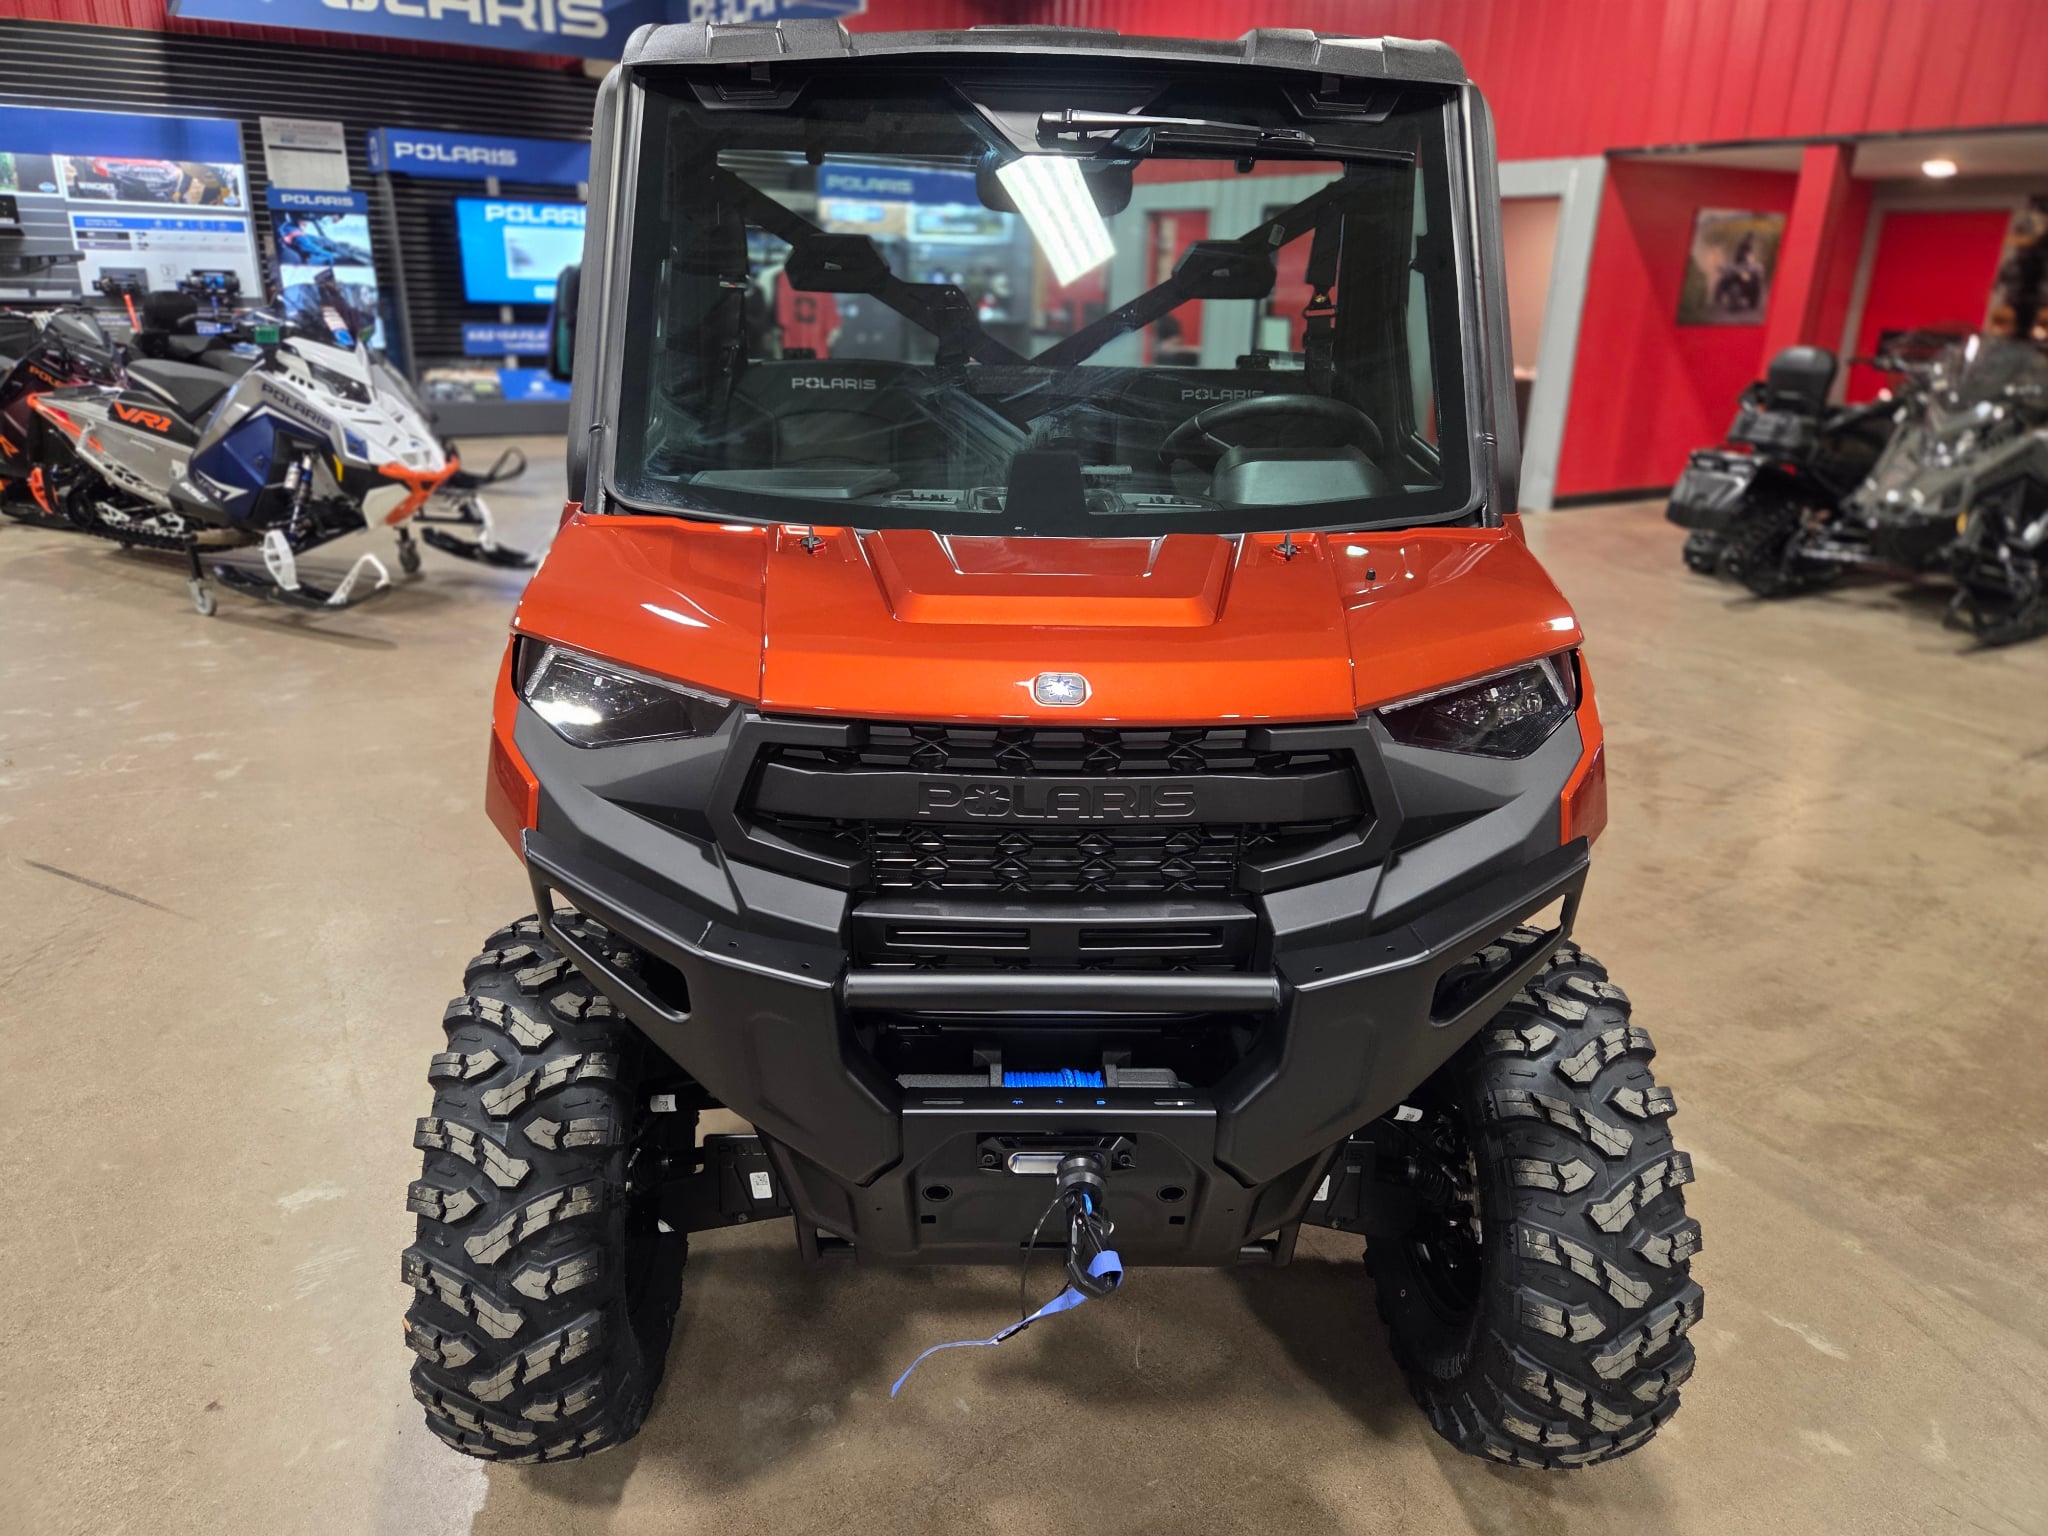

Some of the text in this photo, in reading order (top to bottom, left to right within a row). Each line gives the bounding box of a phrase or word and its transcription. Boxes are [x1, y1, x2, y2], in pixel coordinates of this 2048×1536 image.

[394, 141, 517, 167] POLARIS
[280, 193, 354, 207] POLARIS
[791, 377, 877, 390] POLARIS
[113, 401, 173, 433] VR1
[261, 383, 333, 432] POLARIS
[918, 781, 1197, 818] POLARIS
